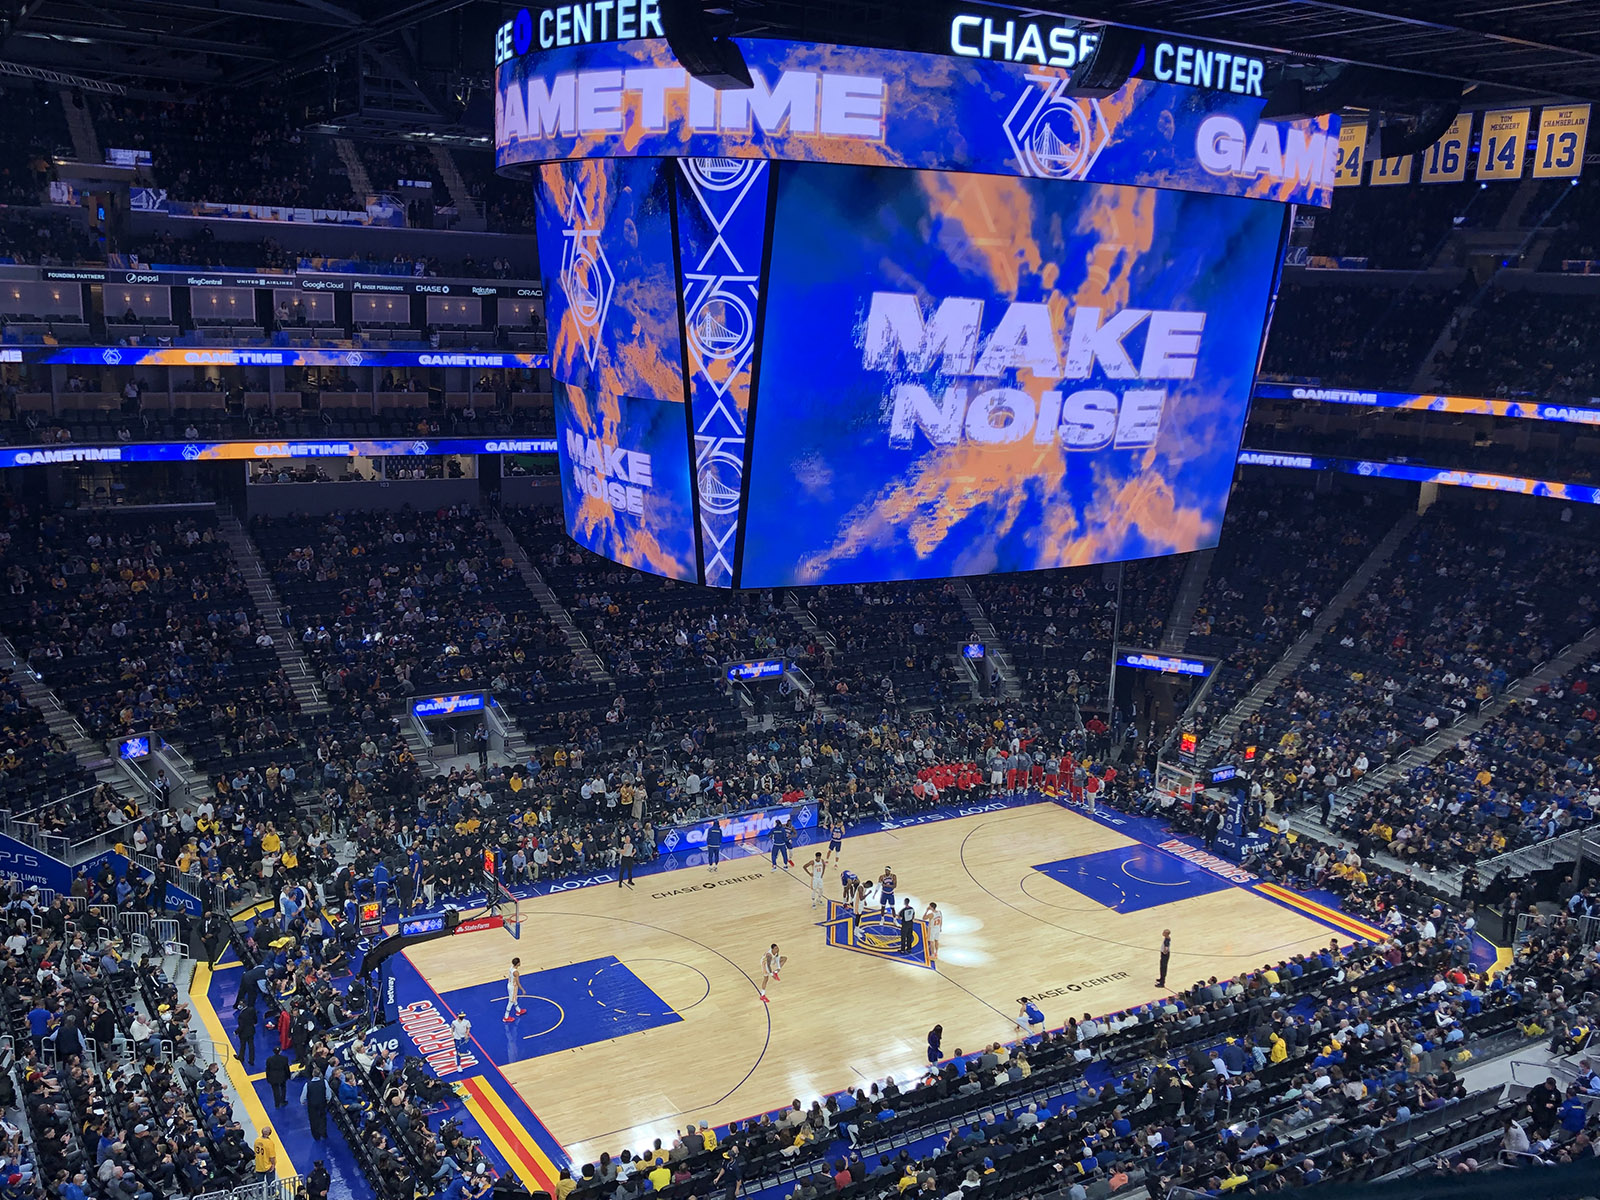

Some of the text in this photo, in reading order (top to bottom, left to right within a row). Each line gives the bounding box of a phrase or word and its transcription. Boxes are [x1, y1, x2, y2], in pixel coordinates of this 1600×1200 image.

[540, 0, 665, 49] CENTER
[1154, 43, 1264, 96] CENTER
[495, 68, 886, 143] AMETIME
[1500, 115, 1513, 123] TOM
[1543, 118, 1586, 128] CHAMBERLAIN
[1558, 111, 1573, 119] WILT
[1490, 123, 1520, 131] MESCHERY
[1429, 140, 1461, 174] 16
[1485, 135, 1517, 171] 14
[1543, 132, 1578, 168] 13
[1335, 146, 1360, 177] 24
[137, 275, 159, 283] pepsi
[188, 277, 222, 286] RingCentral
[302, 280, 344, 289] Google Cloud
[415, 285, 441, 293] CHASE
[472, 286, 497, 295] Rakuten
[862, 291, 1206, 379] MAKE
[184, 352, 283, 364] GAMETIME
[418, 354, 503, 366] GAMETIME
[1292, 388, 1377, 404] GAMETIME
[888, 383, 1166, 451] NOISE
[254, 444, 350, 456] GAMETIME
[485, 441, 558, 452] GAMETIM
[15, 449, 121, 463] GAMETIME
[566, 428, 652, 487] MAKE
[1437, 472, 1526, 491] GAMETIME
[573, 465, 644, 517] NOISE
[1127, 655, 1204, 674] GAMETIME
[416, 698, 480, 712] GAMETIME
[1157, 839, 1259, 883] WARRIORS
[21, 874, 47, 885] LIMITS
[717, 873, 765, 886] CENTER
[651, 884, 701, 900] CHASE
[1081, 971, 1131, 988] CENTER
[387, 976, 396, 1005] betway
